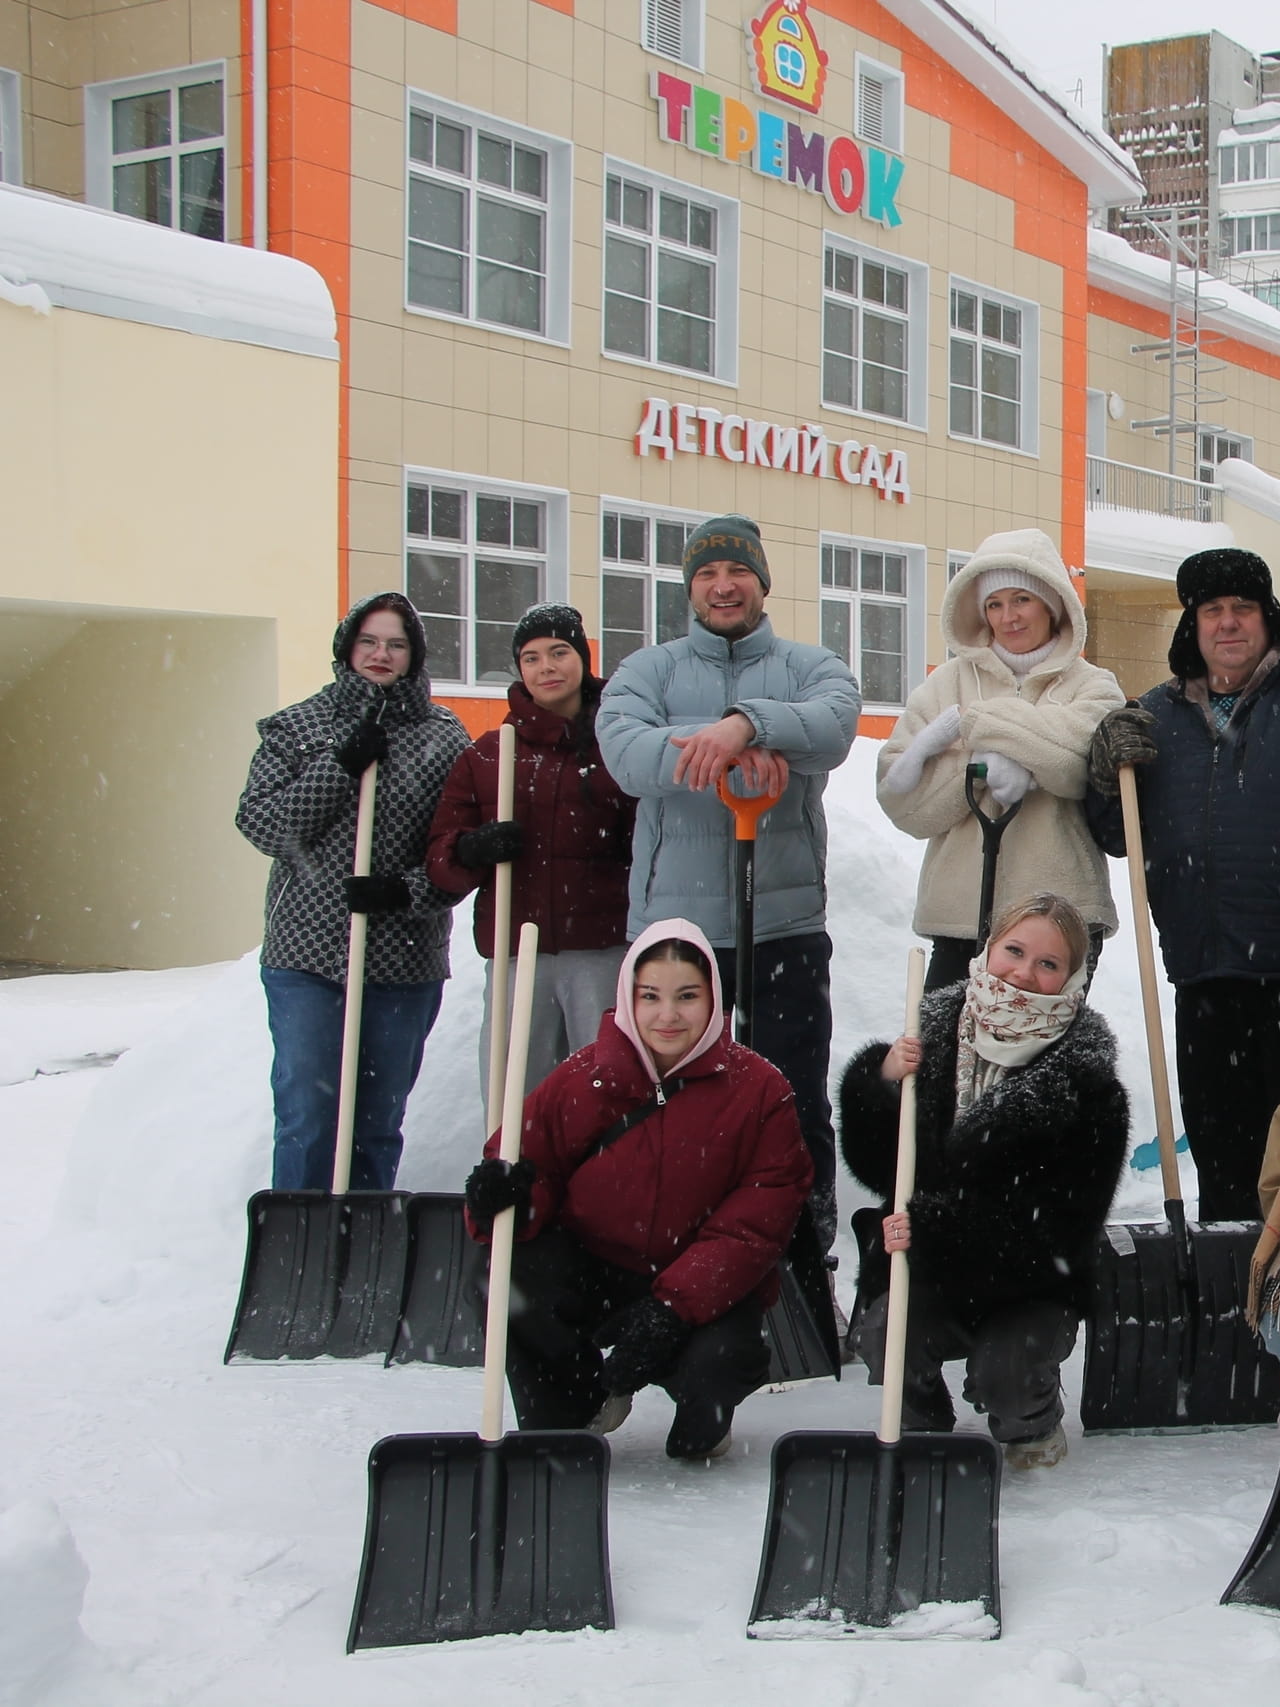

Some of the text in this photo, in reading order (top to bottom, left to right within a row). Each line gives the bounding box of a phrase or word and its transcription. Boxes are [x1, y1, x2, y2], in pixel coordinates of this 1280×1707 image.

[650, 70, 905, 228] ТЕРЕМОК
[634, 397, 911, 504] ДЕТСКИЙ САД
